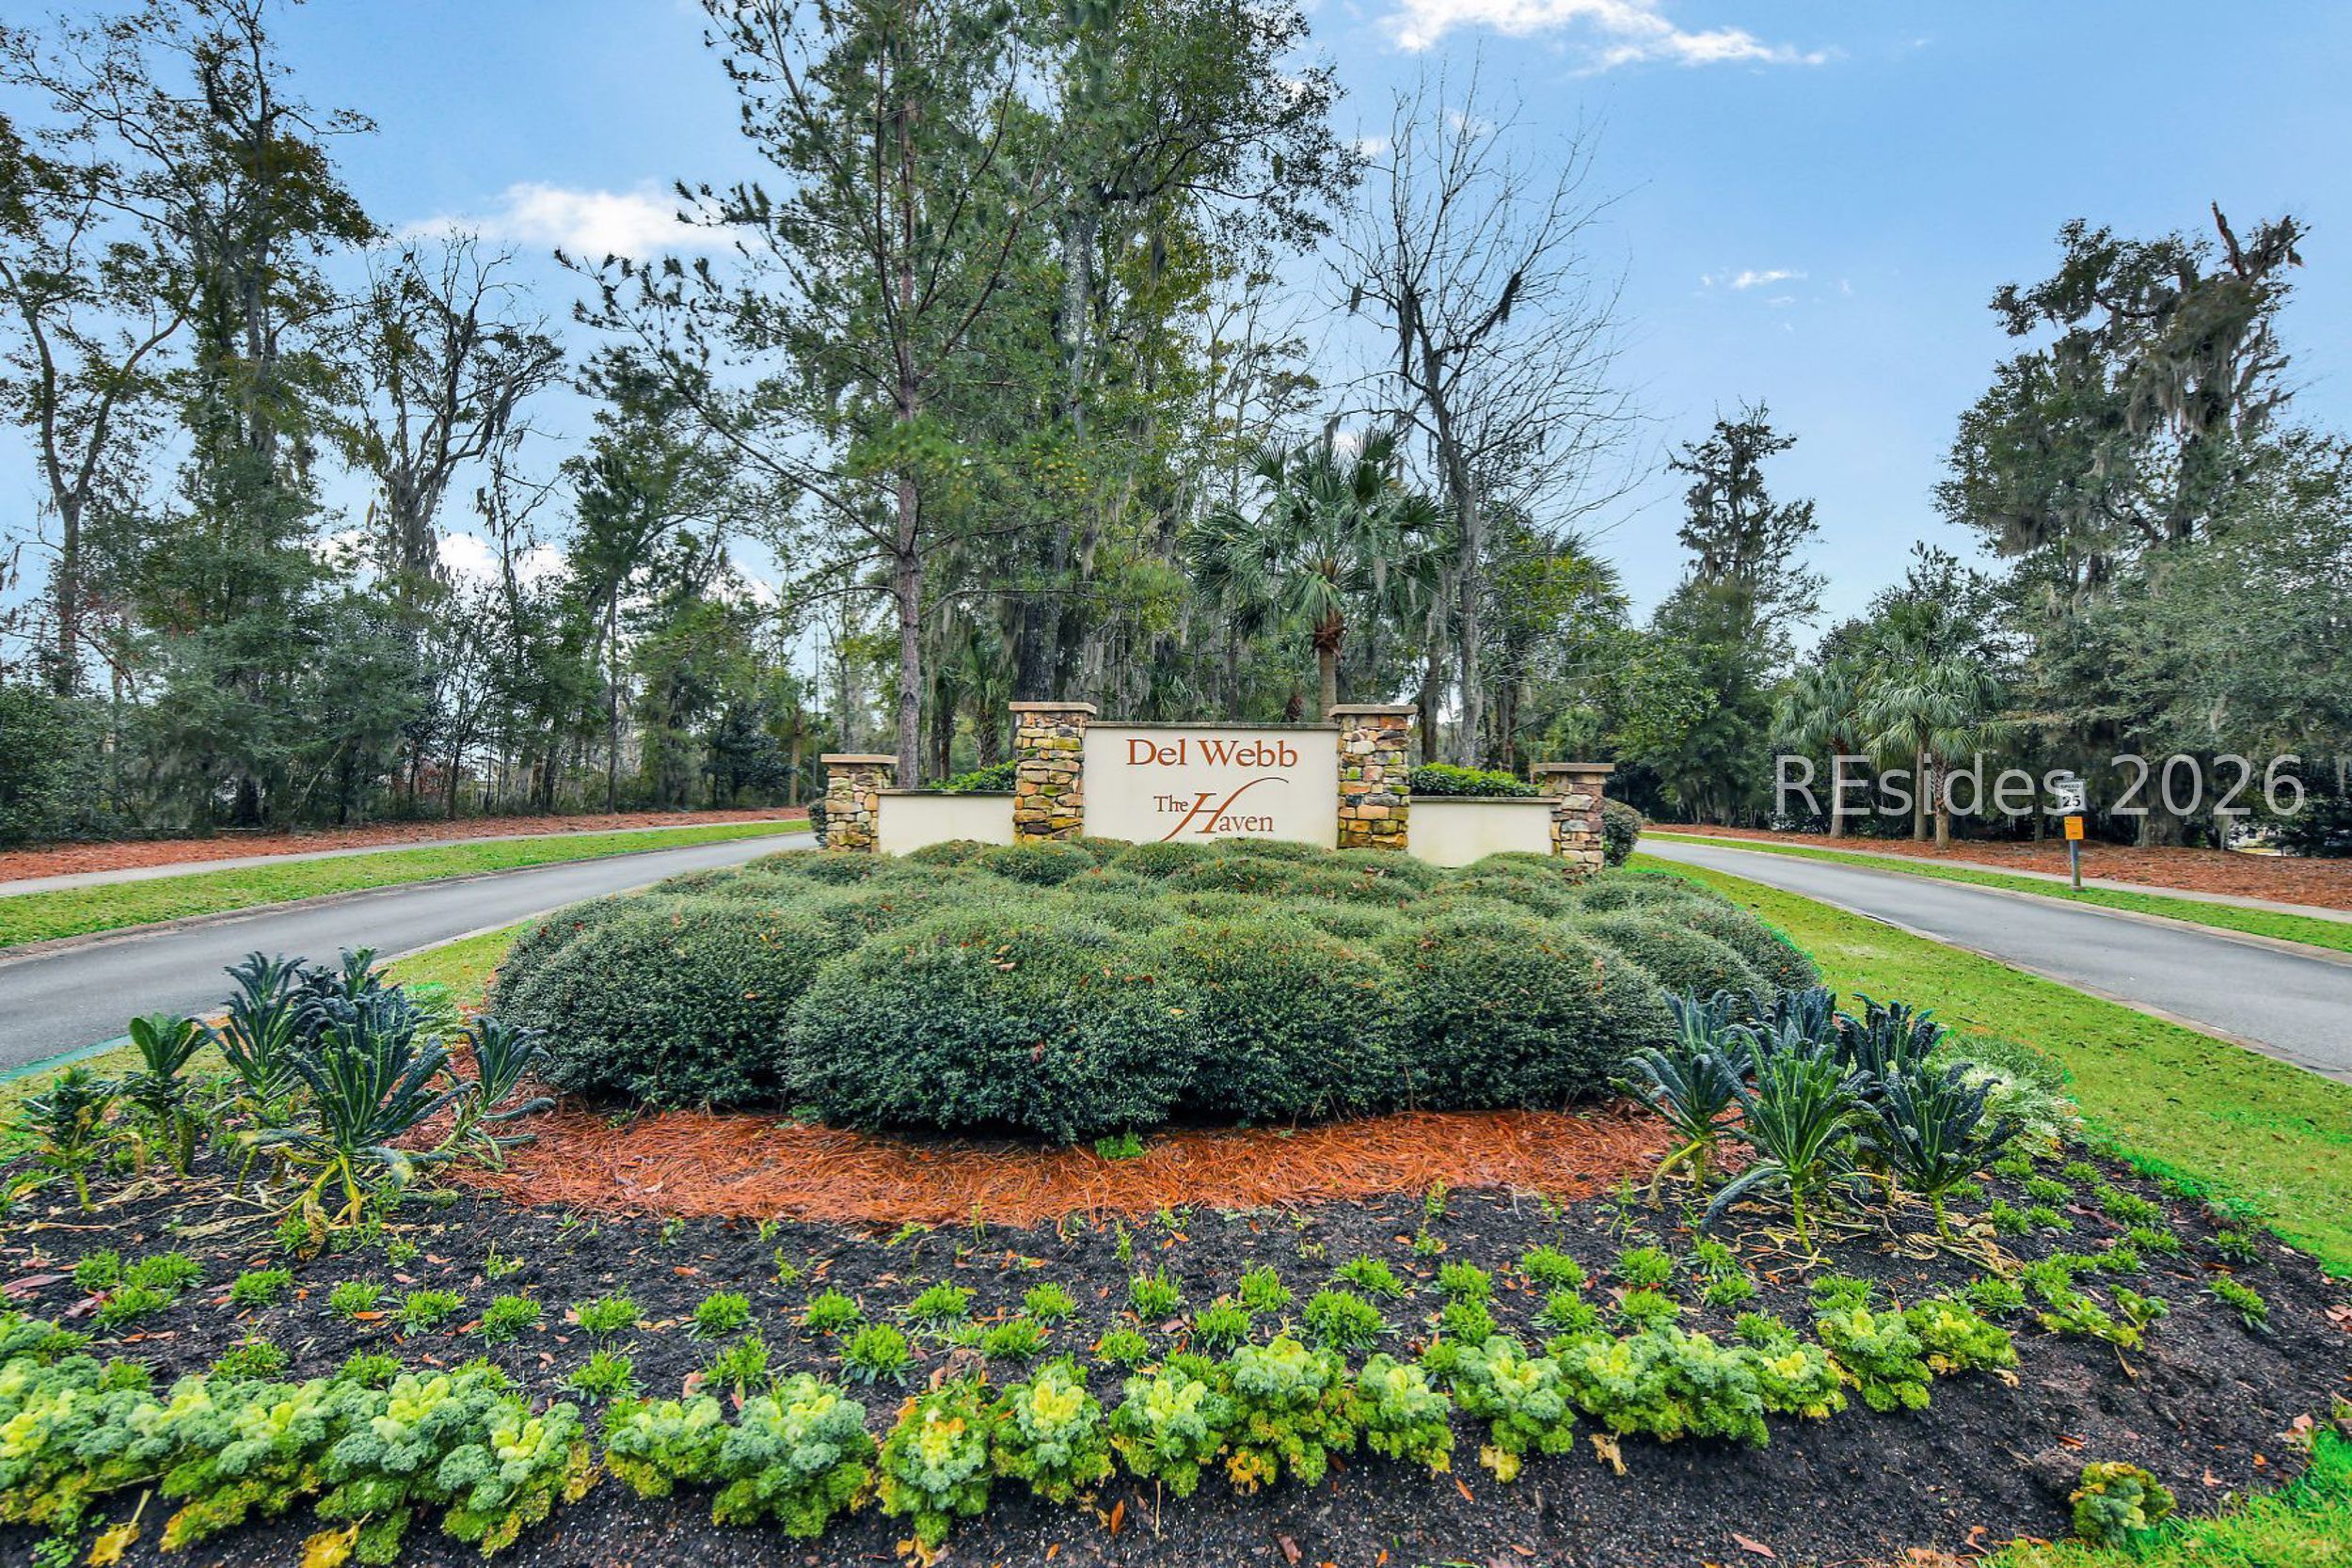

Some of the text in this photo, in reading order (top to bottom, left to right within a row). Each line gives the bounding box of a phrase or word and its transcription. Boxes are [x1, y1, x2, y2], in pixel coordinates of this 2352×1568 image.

[1126, 738, 1298, 768] Del Webb
[1153, 777, 1289, 842] The Haven
[2062, 795, 2081, 807] 25
